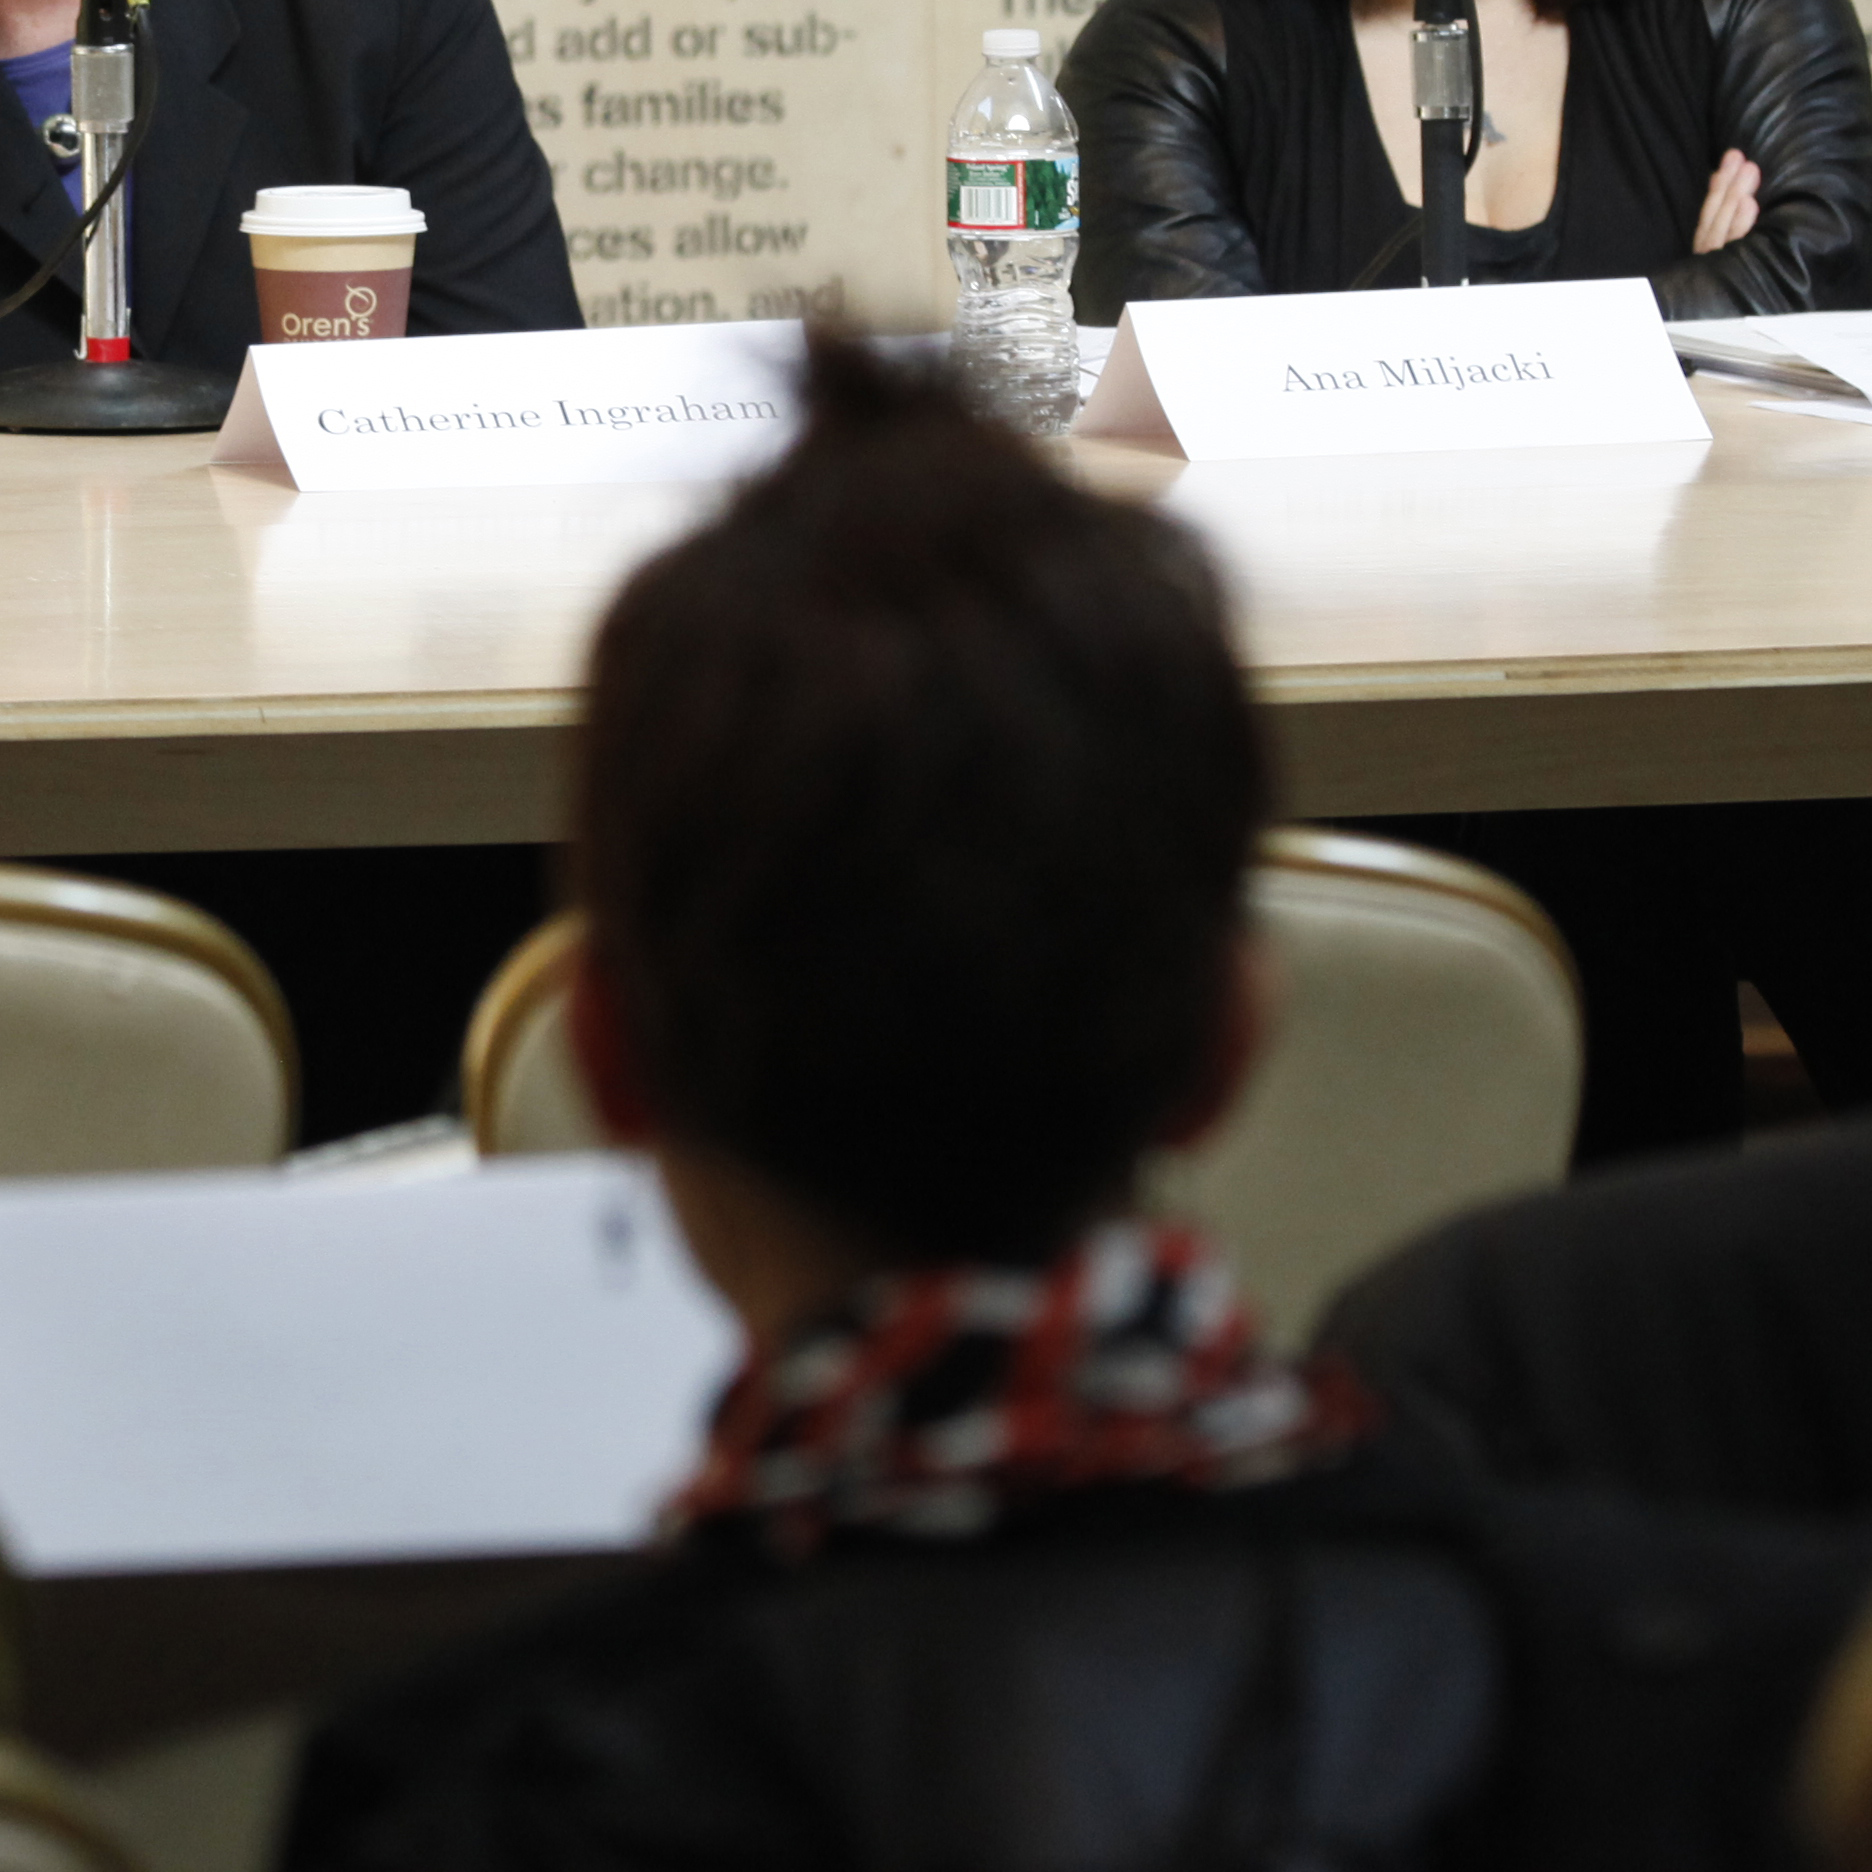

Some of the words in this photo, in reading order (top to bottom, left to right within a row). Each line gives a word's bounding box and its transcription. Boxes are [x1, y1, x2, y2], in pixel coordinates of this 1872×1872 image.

[672, 211, 808, 259] allow
[281, 312, 371, 337] Oren's
[1282, 364, 1368, 392] Ana
[1373, 352, 1555, 392] Miljacki
[317, 403, 542, 435] Catherine
[553, 395, 782, 431] Ingraham
